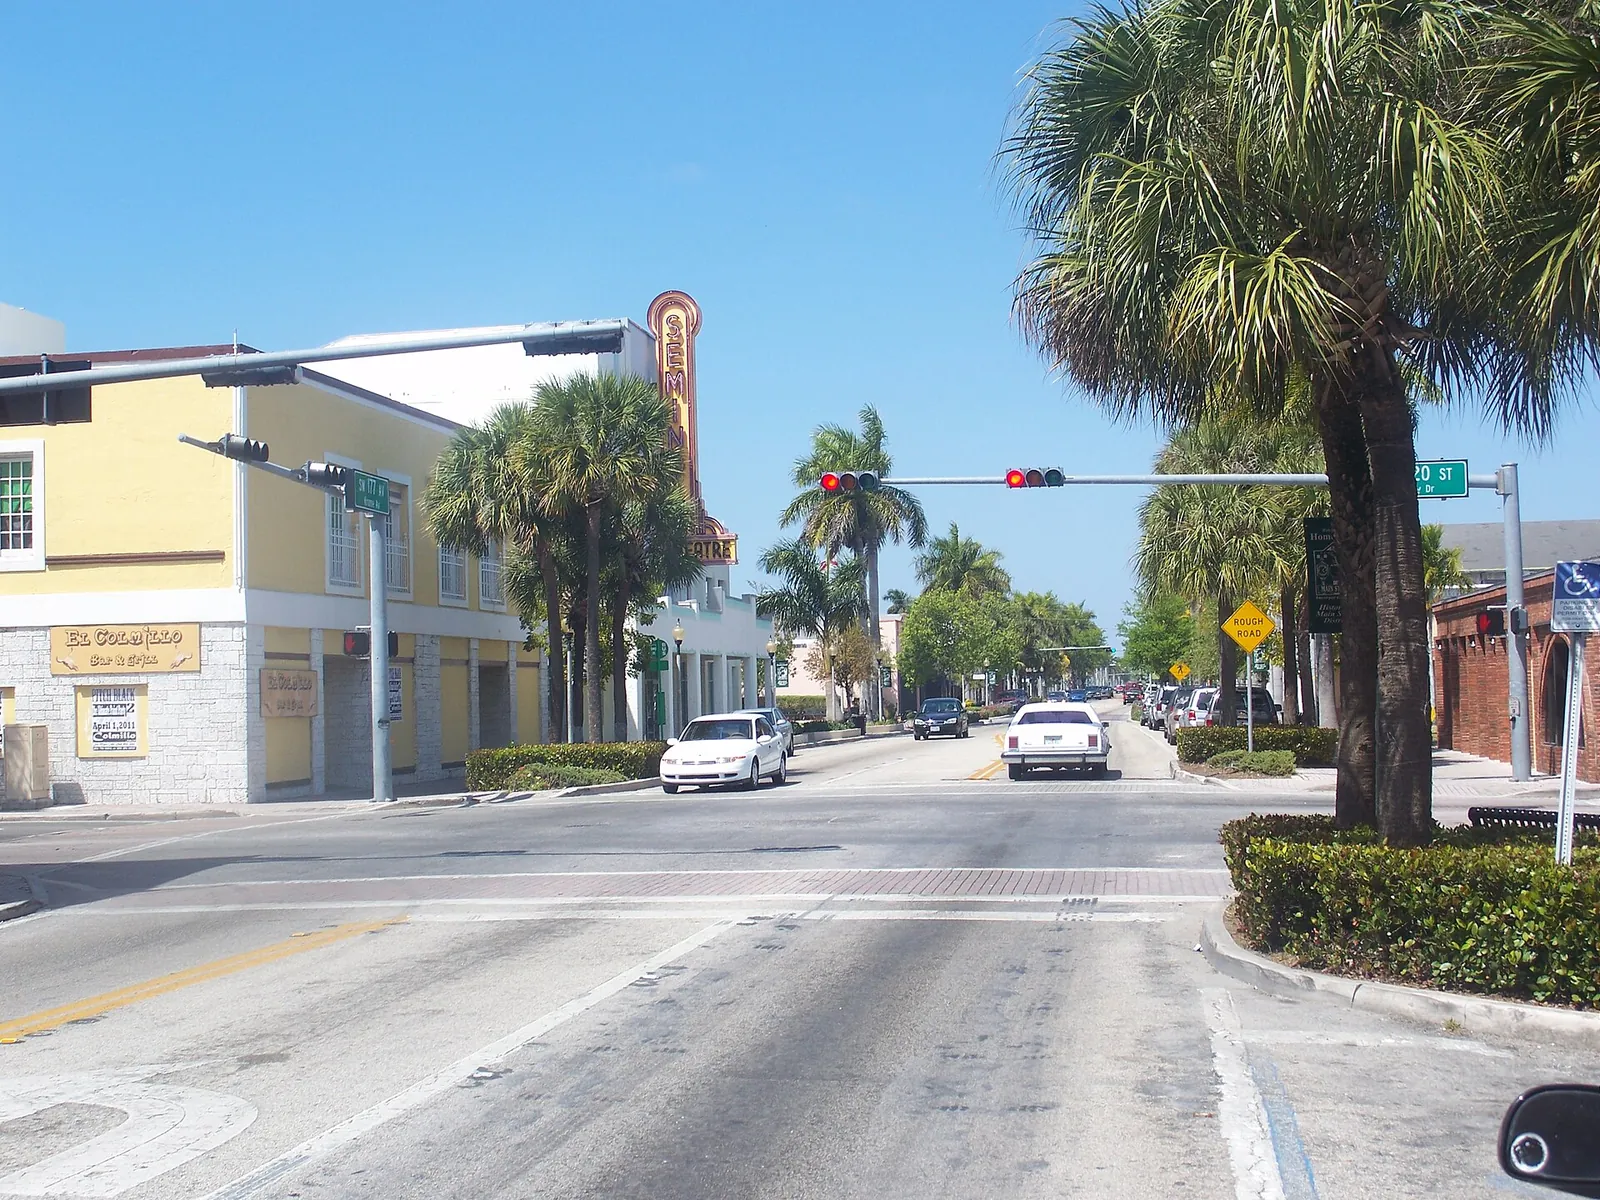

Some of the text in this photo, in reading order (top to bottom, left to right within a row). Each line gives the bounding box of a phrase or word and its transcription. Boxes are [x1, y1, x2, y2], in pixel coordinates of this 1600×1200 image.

[665, 314, 685, 452] SEMIN
[1415, 465, 1452, 481] 20 ST
[367, 477, 376, 495] 177
[1425, 484, 1435, 493] Dr
[1234, 618, 1263, 626] ROUGH
[1237, 629, 1261, 638] ROAD
[90, 654, 113, 667] Bar
[114, 654, 125, 666] &
[92, 687, 136, 702] PITCH BLACK
[93, 721, 111, 732] April
[93, 731, 136, 742] Colmillo
